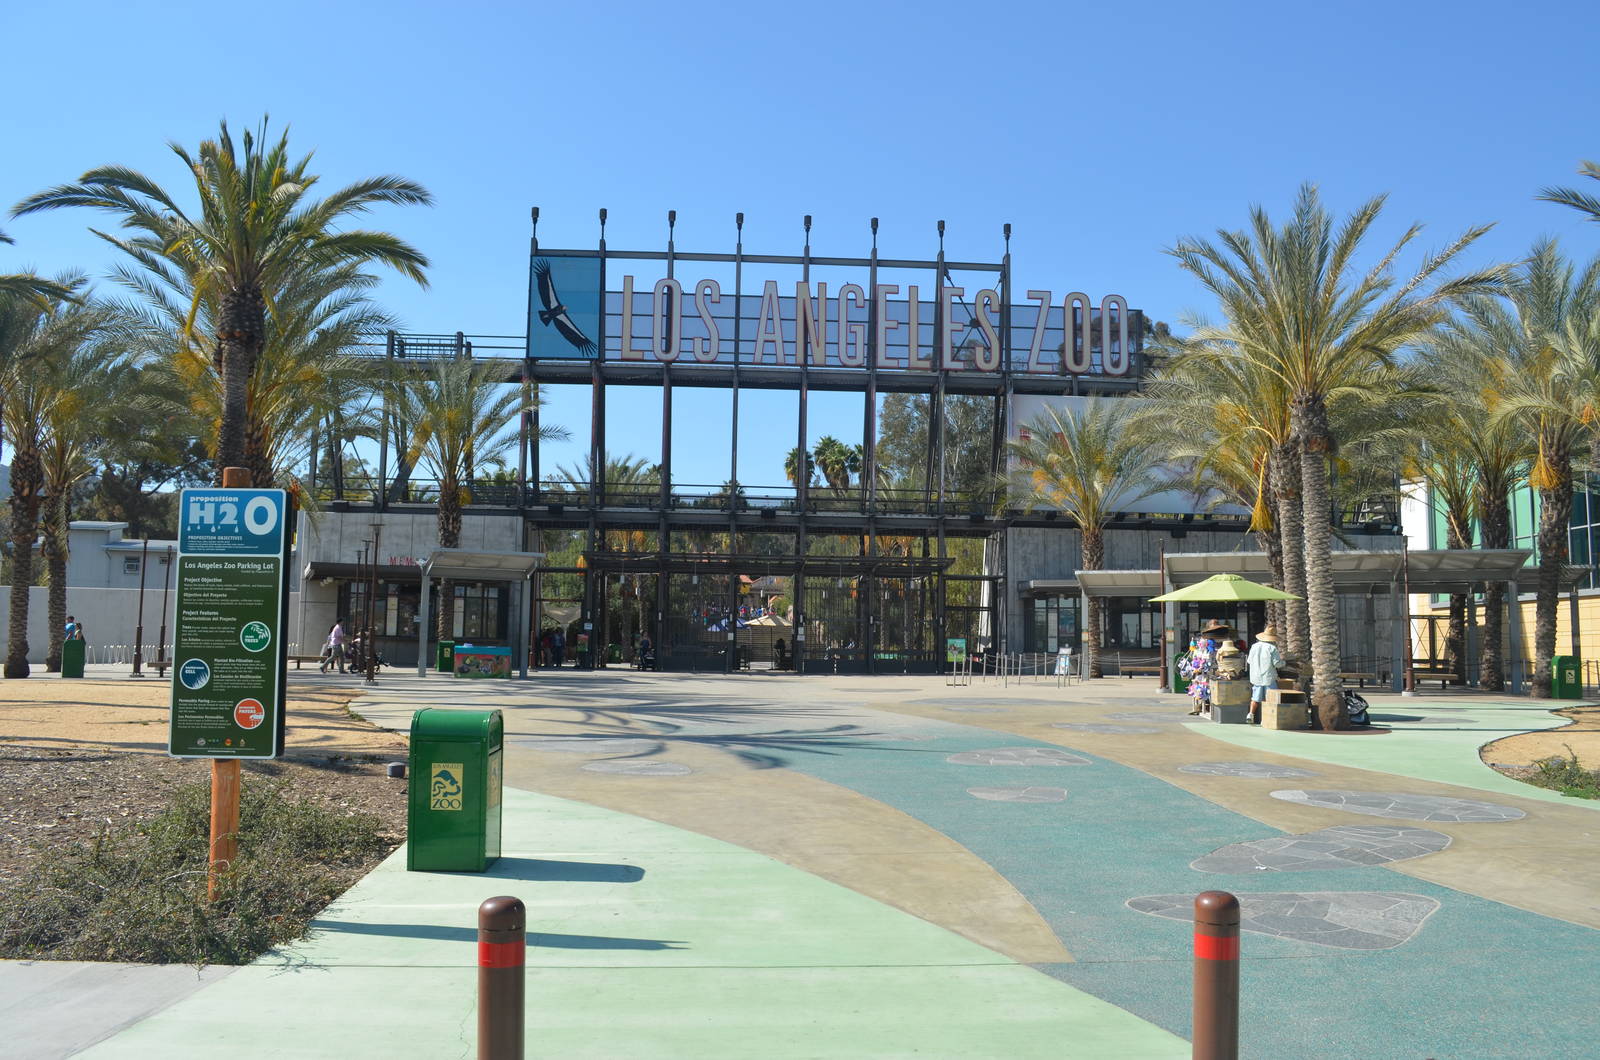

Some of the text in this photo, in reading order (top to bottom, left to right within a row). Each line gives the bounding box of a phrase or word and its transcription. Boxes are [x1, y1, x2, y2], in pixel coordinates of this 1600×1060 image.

[621, 275, 1129, 377] LOS ANGELES ZOO
[198, 562, 222, 570] Angeles
[432, 798, 461, 809] ZOO
